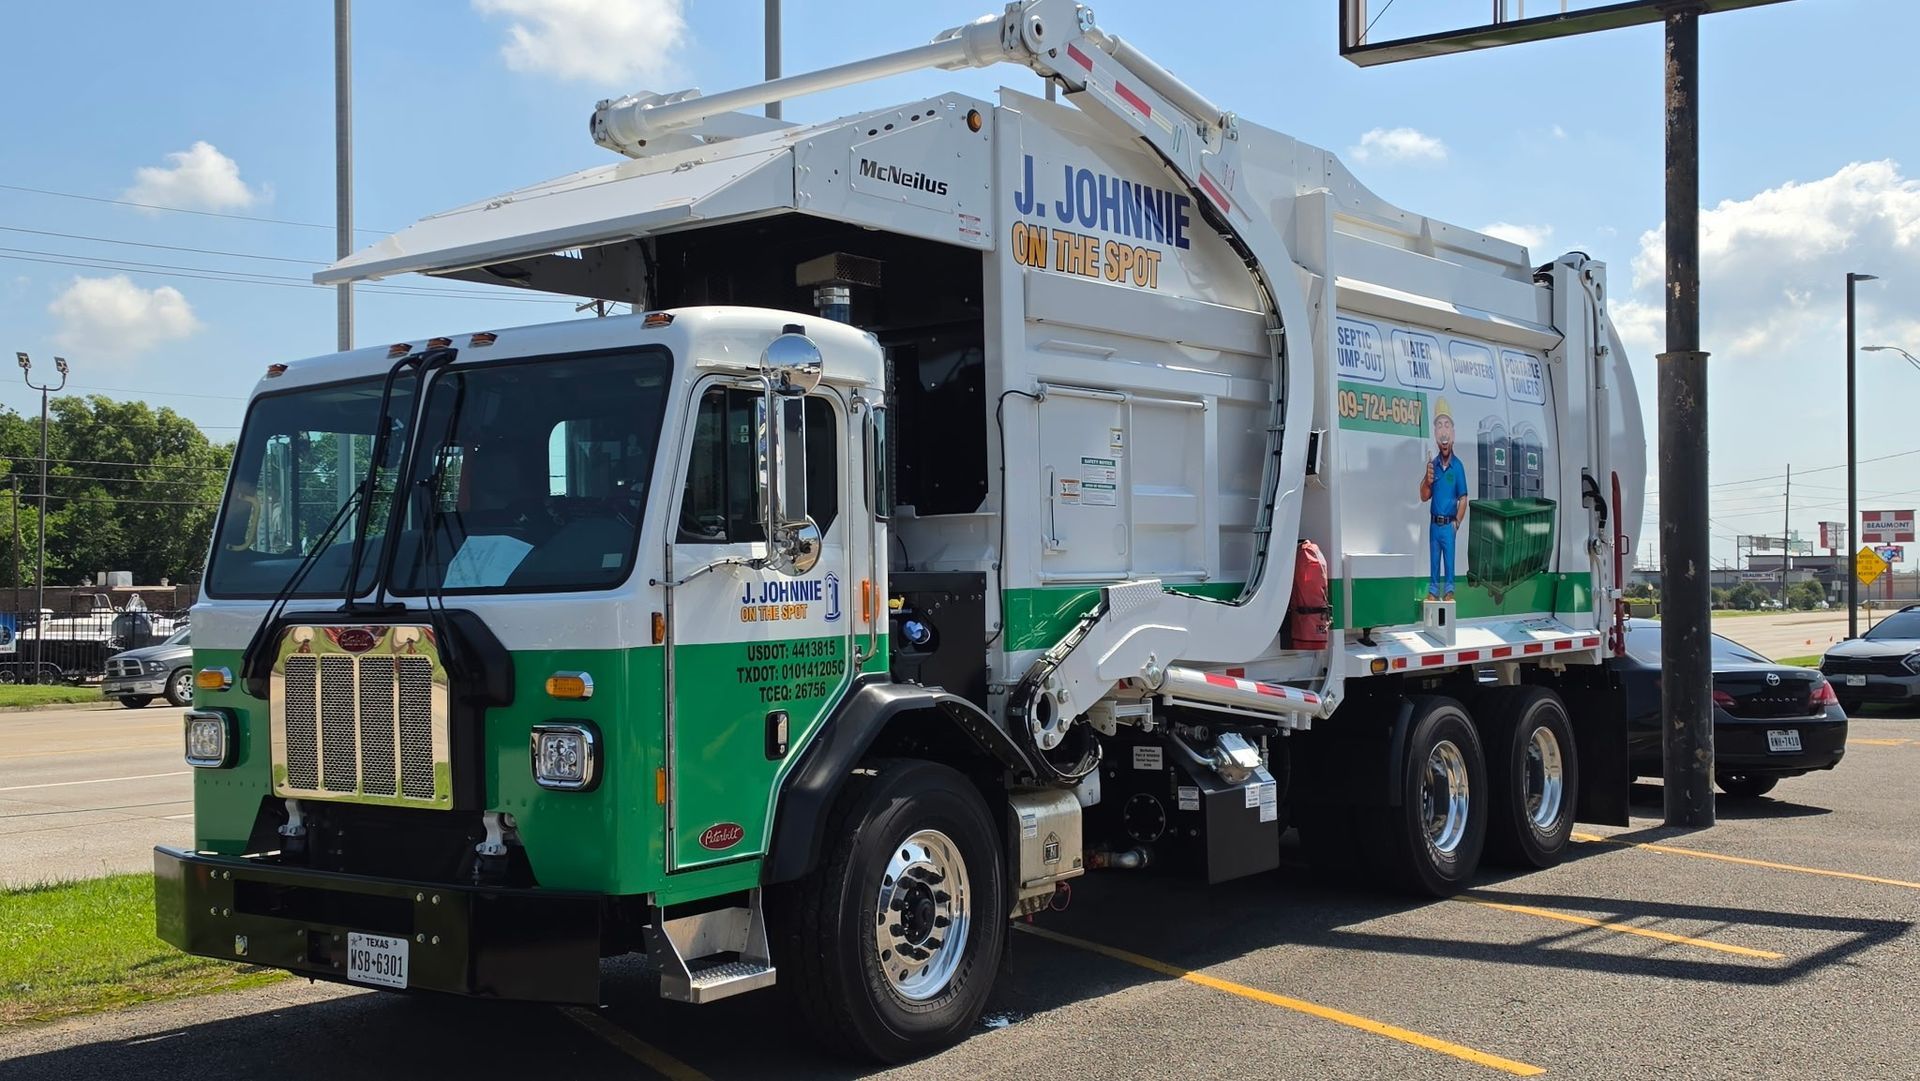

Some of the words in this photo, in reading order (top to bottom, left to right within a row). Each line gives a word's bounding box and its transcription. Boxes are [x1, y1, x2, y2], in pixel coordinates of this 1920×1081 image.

[859, 158, 949, 196] McNeilus
[1014, 154, 1046, 218] J.
[1055, 164, 1191, 250] JOHNNIE
[1011, 220, 1048, 268] ON
[1052, 228, 1100, 278] THE
[1104, 239, 1162, 289] SPOT
[1337, 326, 1372, 350] SEPTIC
[1337, 347, 1382, 372] UMP-OUT
[1400, 339, 1432, 360] WATER
[1407, 360, 1432, 380] TANK
[1453, 359, 1494, 380] DUMPSTERS
[1504, 358, 1540, 379] PORTABLE
[1511, 377, 1540, 396] TOILETS
[1337, 389, 1422, 427] 09-724-6647
[741, 582, 756, 605] J.
[759, 580, 822, 604] JOHNNIE
[740, 606, 757, 622] ON
[758, 605, 779, 622] THE
[781, 604, 808, 620] SPOT
[747, 643, 789, 661] USDOT:
[792, 640, 836, 658] 4413815
[736, 665, 779, 683] TXDOT:
[759, 685, 792, 703] TCEQ:
[795, 682, 826, 699] 26756
[366, 937, 389, 949] TEXAS
